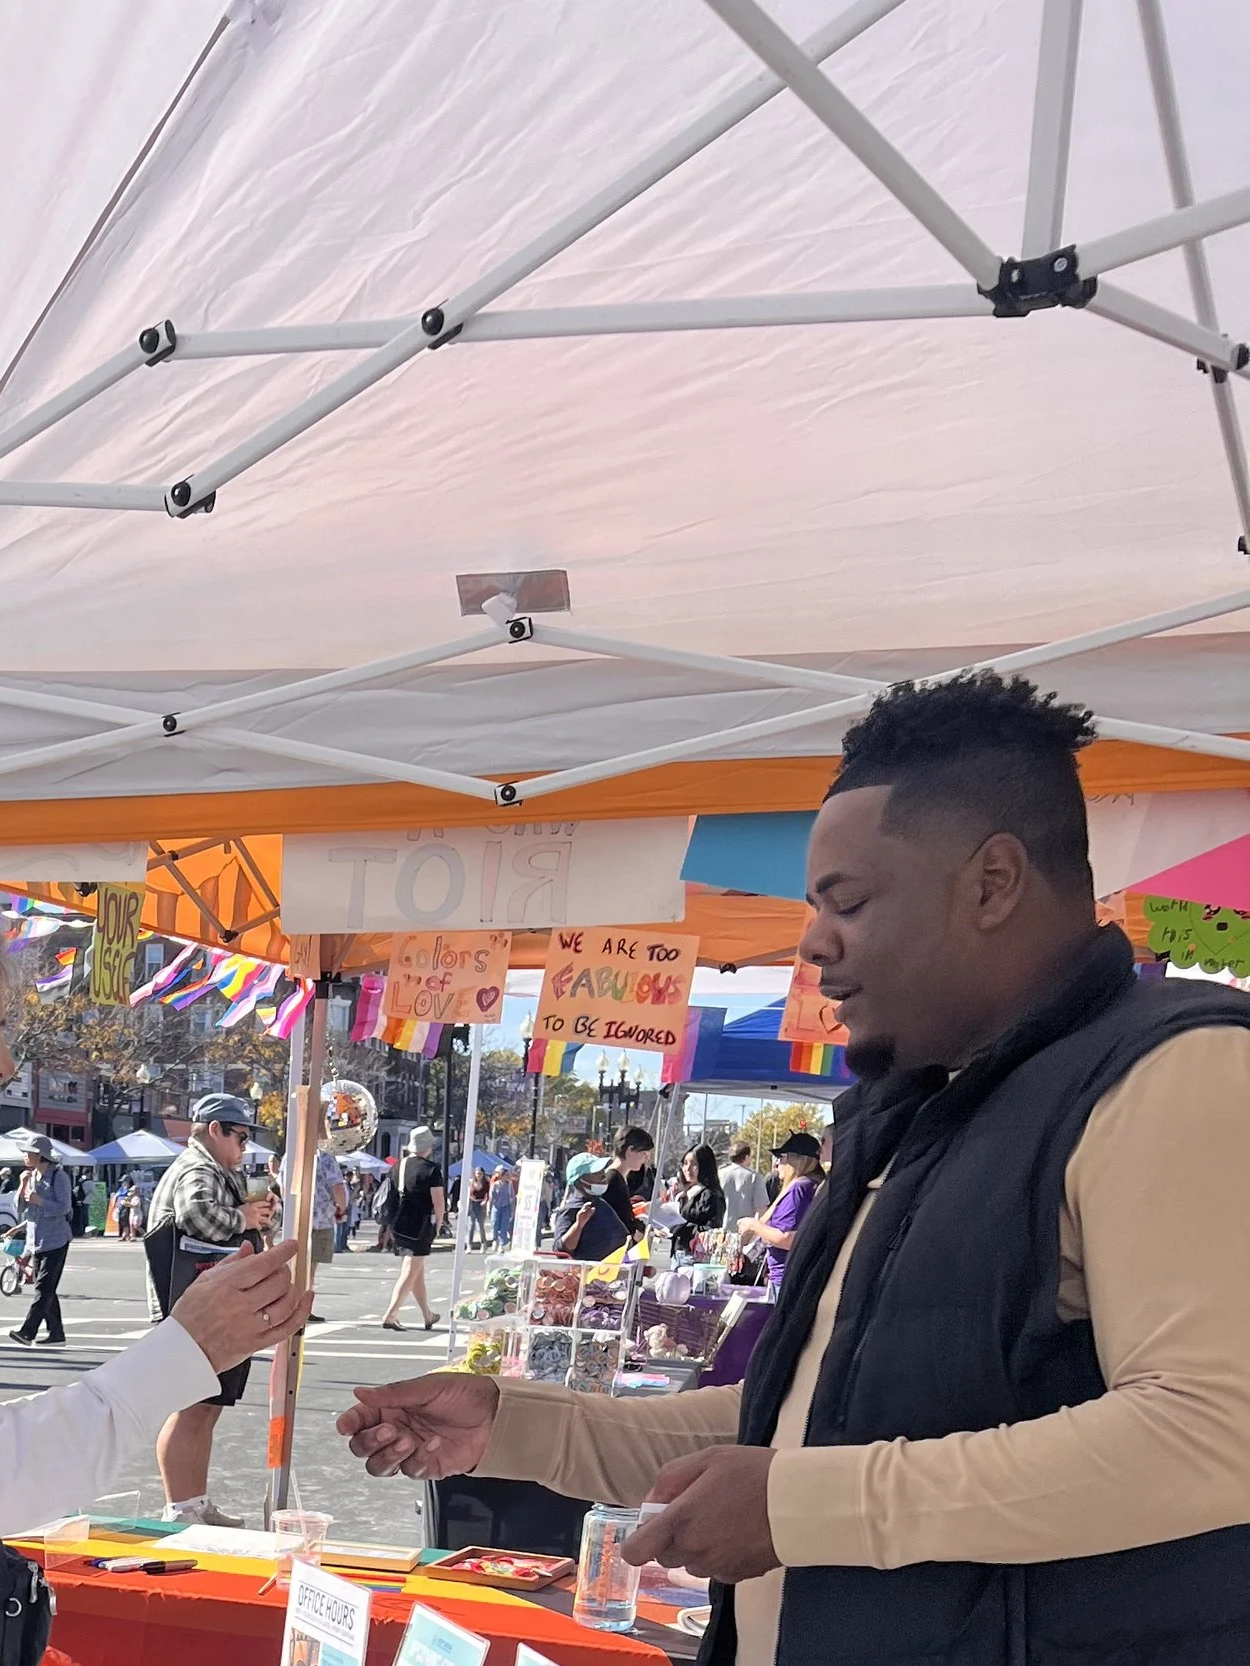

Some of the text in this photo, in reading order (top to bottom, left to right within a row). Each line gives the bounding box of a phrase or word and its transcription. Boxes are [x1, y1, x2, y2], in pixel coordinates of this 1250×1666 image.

[558, 931, 681, 962] WE ARE TOO
[425, 971, 452, 992] of
[551, 961, 687, 1005] FABULOUS
[391, 981, 478, 1019] LOVE
[543, 1014, 677, 1045] TO BE IGNORED
[297, 1584, 326, 1617] OFFICE
[325, 1599, 356, 1631] HOURS
